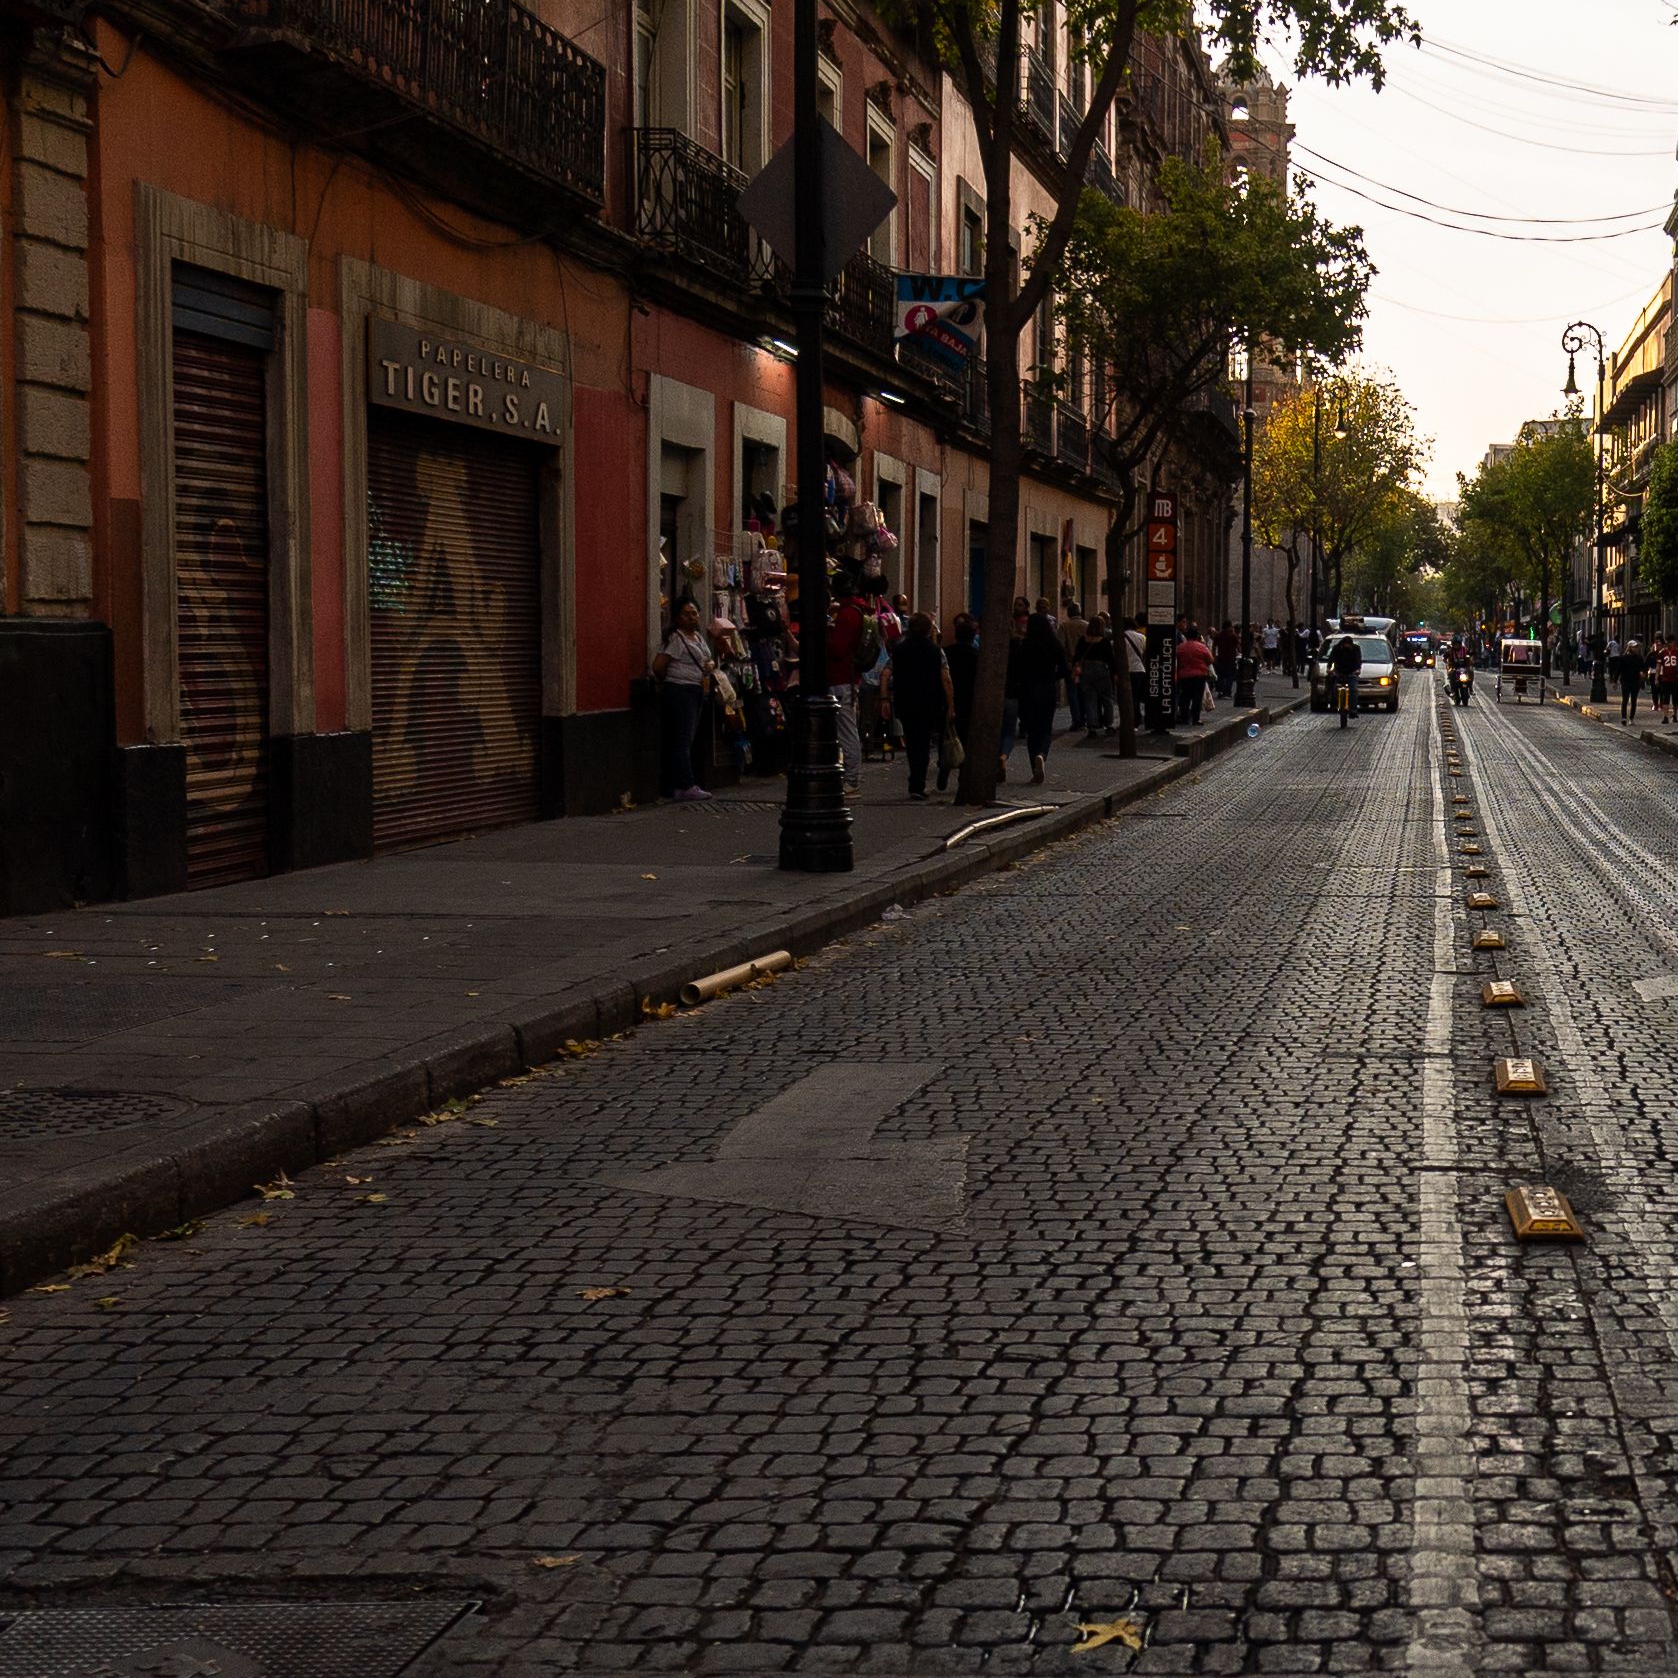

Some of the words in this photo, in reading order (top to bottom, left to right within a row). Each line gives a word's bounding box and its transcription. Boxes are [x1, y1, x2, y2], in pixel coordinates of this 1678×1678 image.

[420, 340, 530, 388] PAPELERA
[381, 359, 497, 423] TIGER,
[505, 394, 561, 435] S.A.
[1152, 527, 1168, 546] 4
[1149, 654, 1159, 697] ISABEL
[1663, 655, 1677, 667] 26
[1161, 698, 1172, 714] LA
